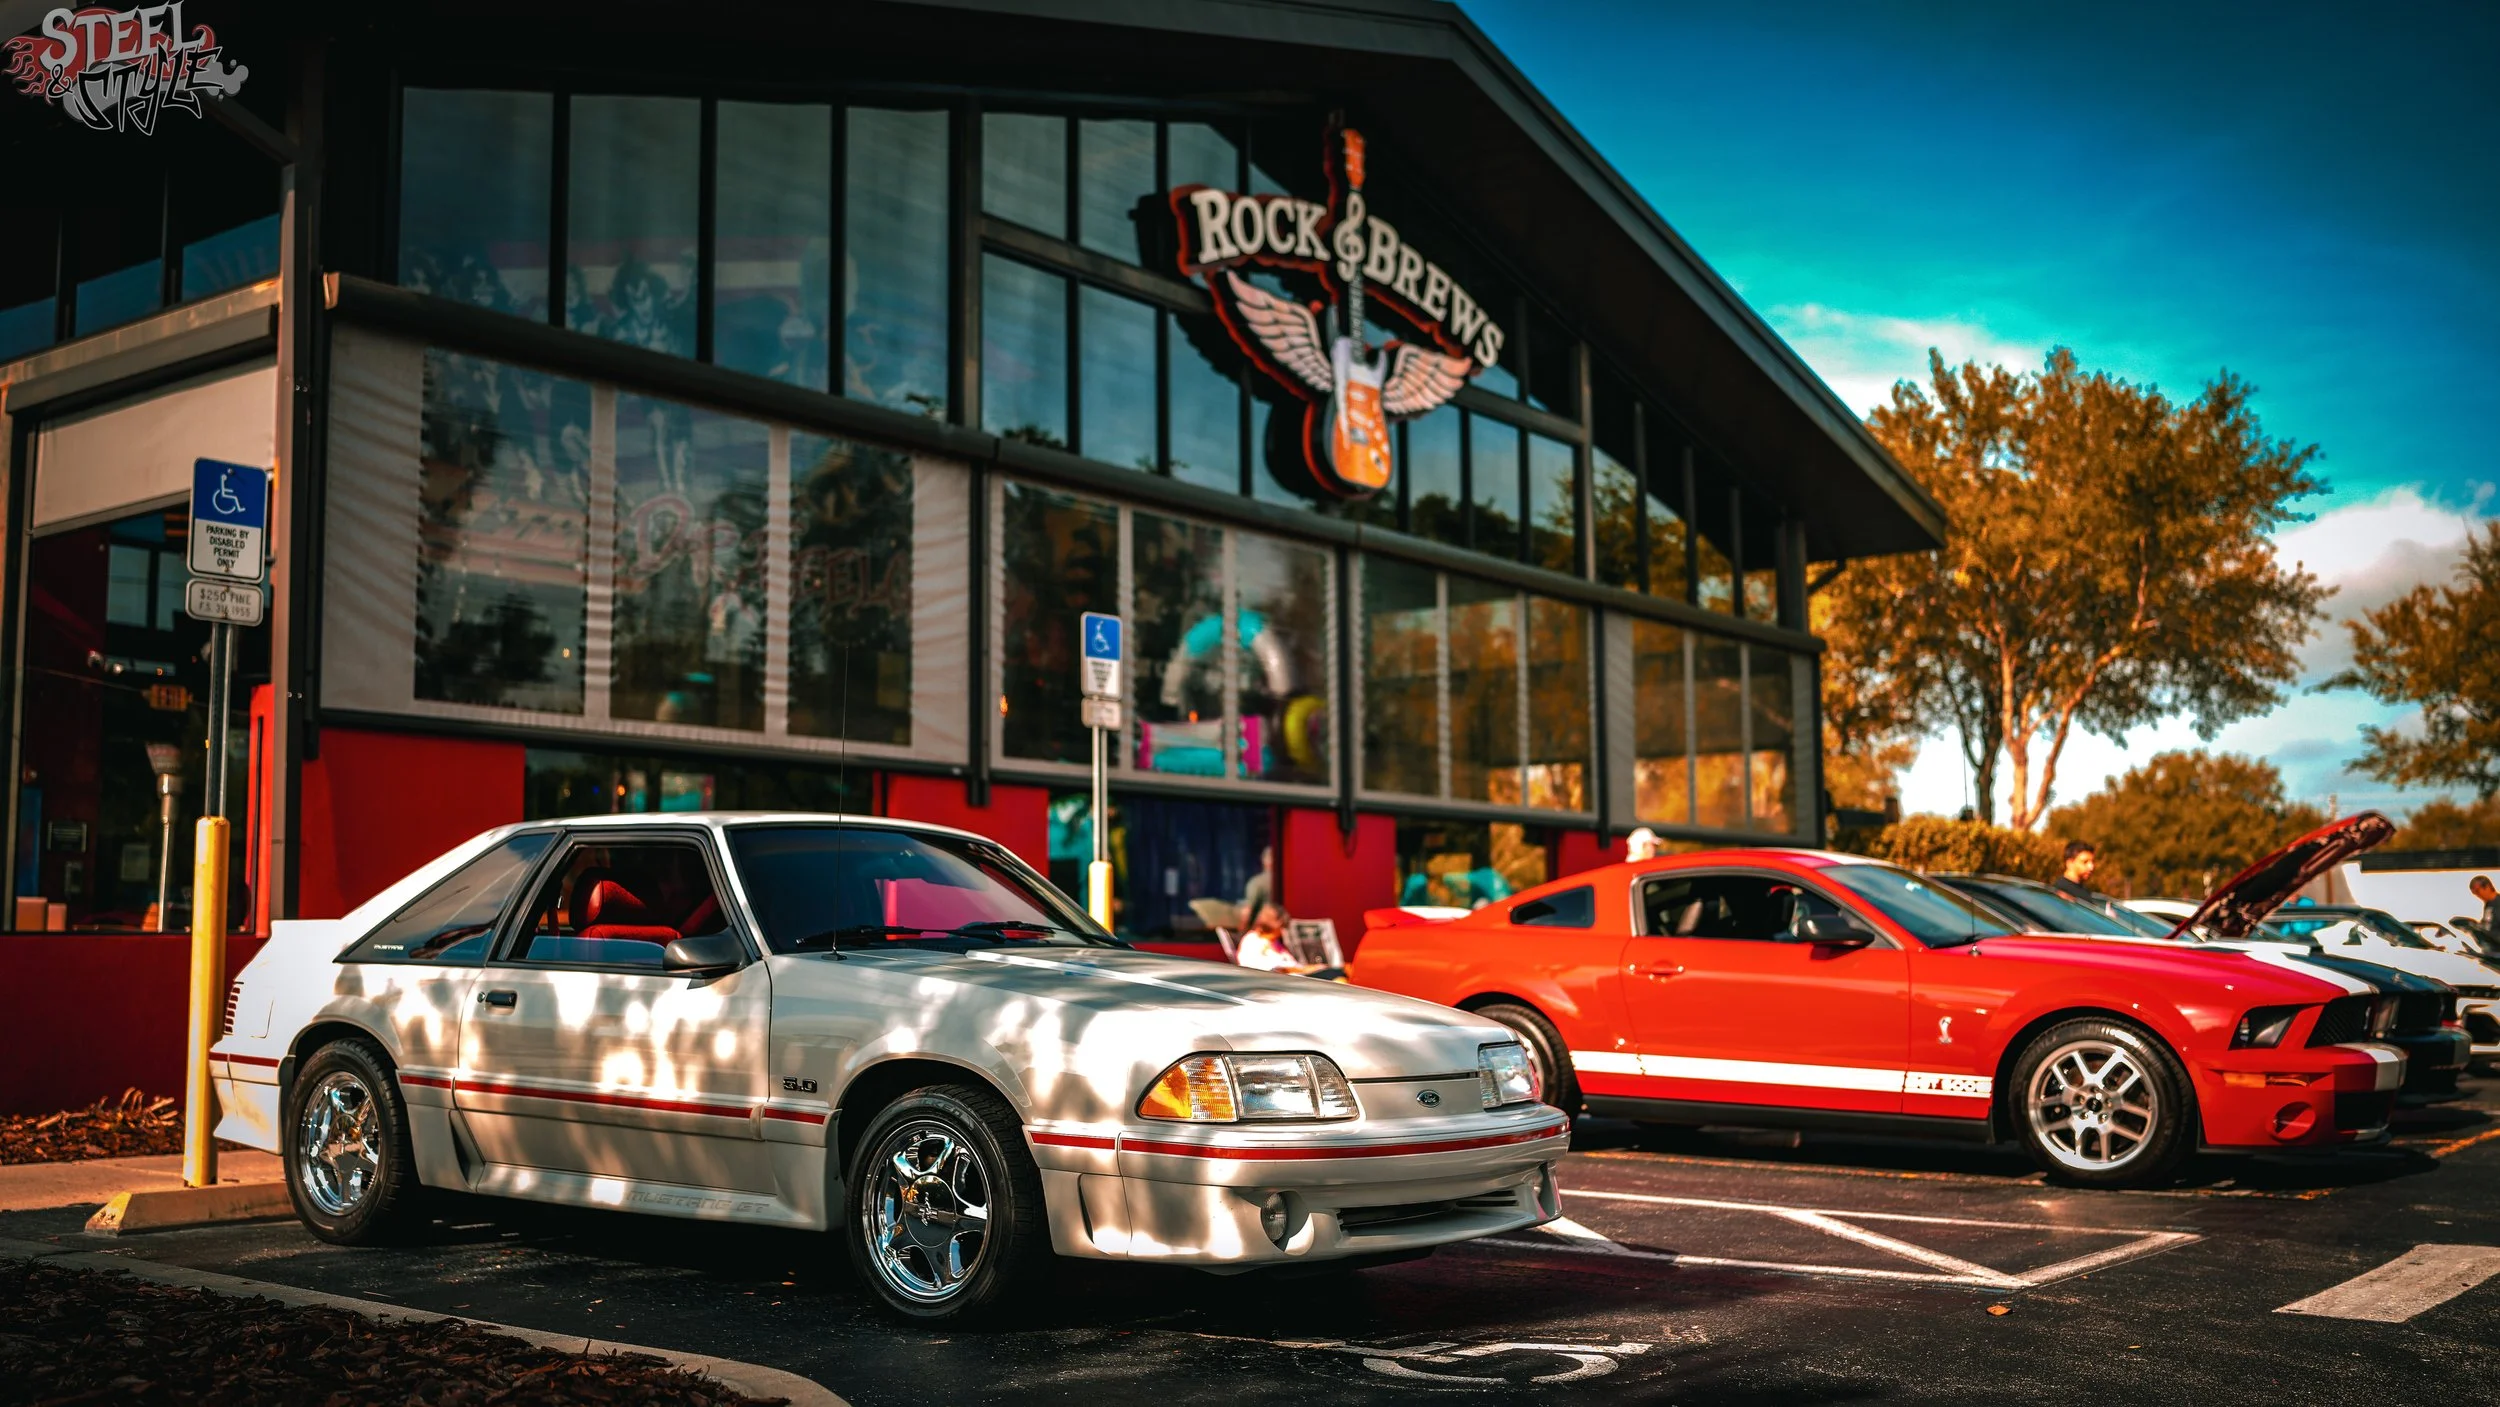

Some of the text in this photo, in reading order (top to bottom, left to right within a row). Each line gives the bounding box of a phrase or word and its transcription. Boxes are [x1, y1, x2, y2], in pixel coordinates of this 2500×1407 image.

[1191, 188, 1331, 264] ROCK
[1363, 216, 1505, 368] BREWS
[206, 524, 249, 539] PARKING BY
[209, 536, 246, 550] DISABLED
[213, 547, 240, 559] PERMIT
[217, 557, 236, 569] ONLY
[200, 588, 252, 606] $250 FINE
[783, 1076, 818, 1094] 5.0
[628, 1190, 770, 1214] MUSTANG GT
